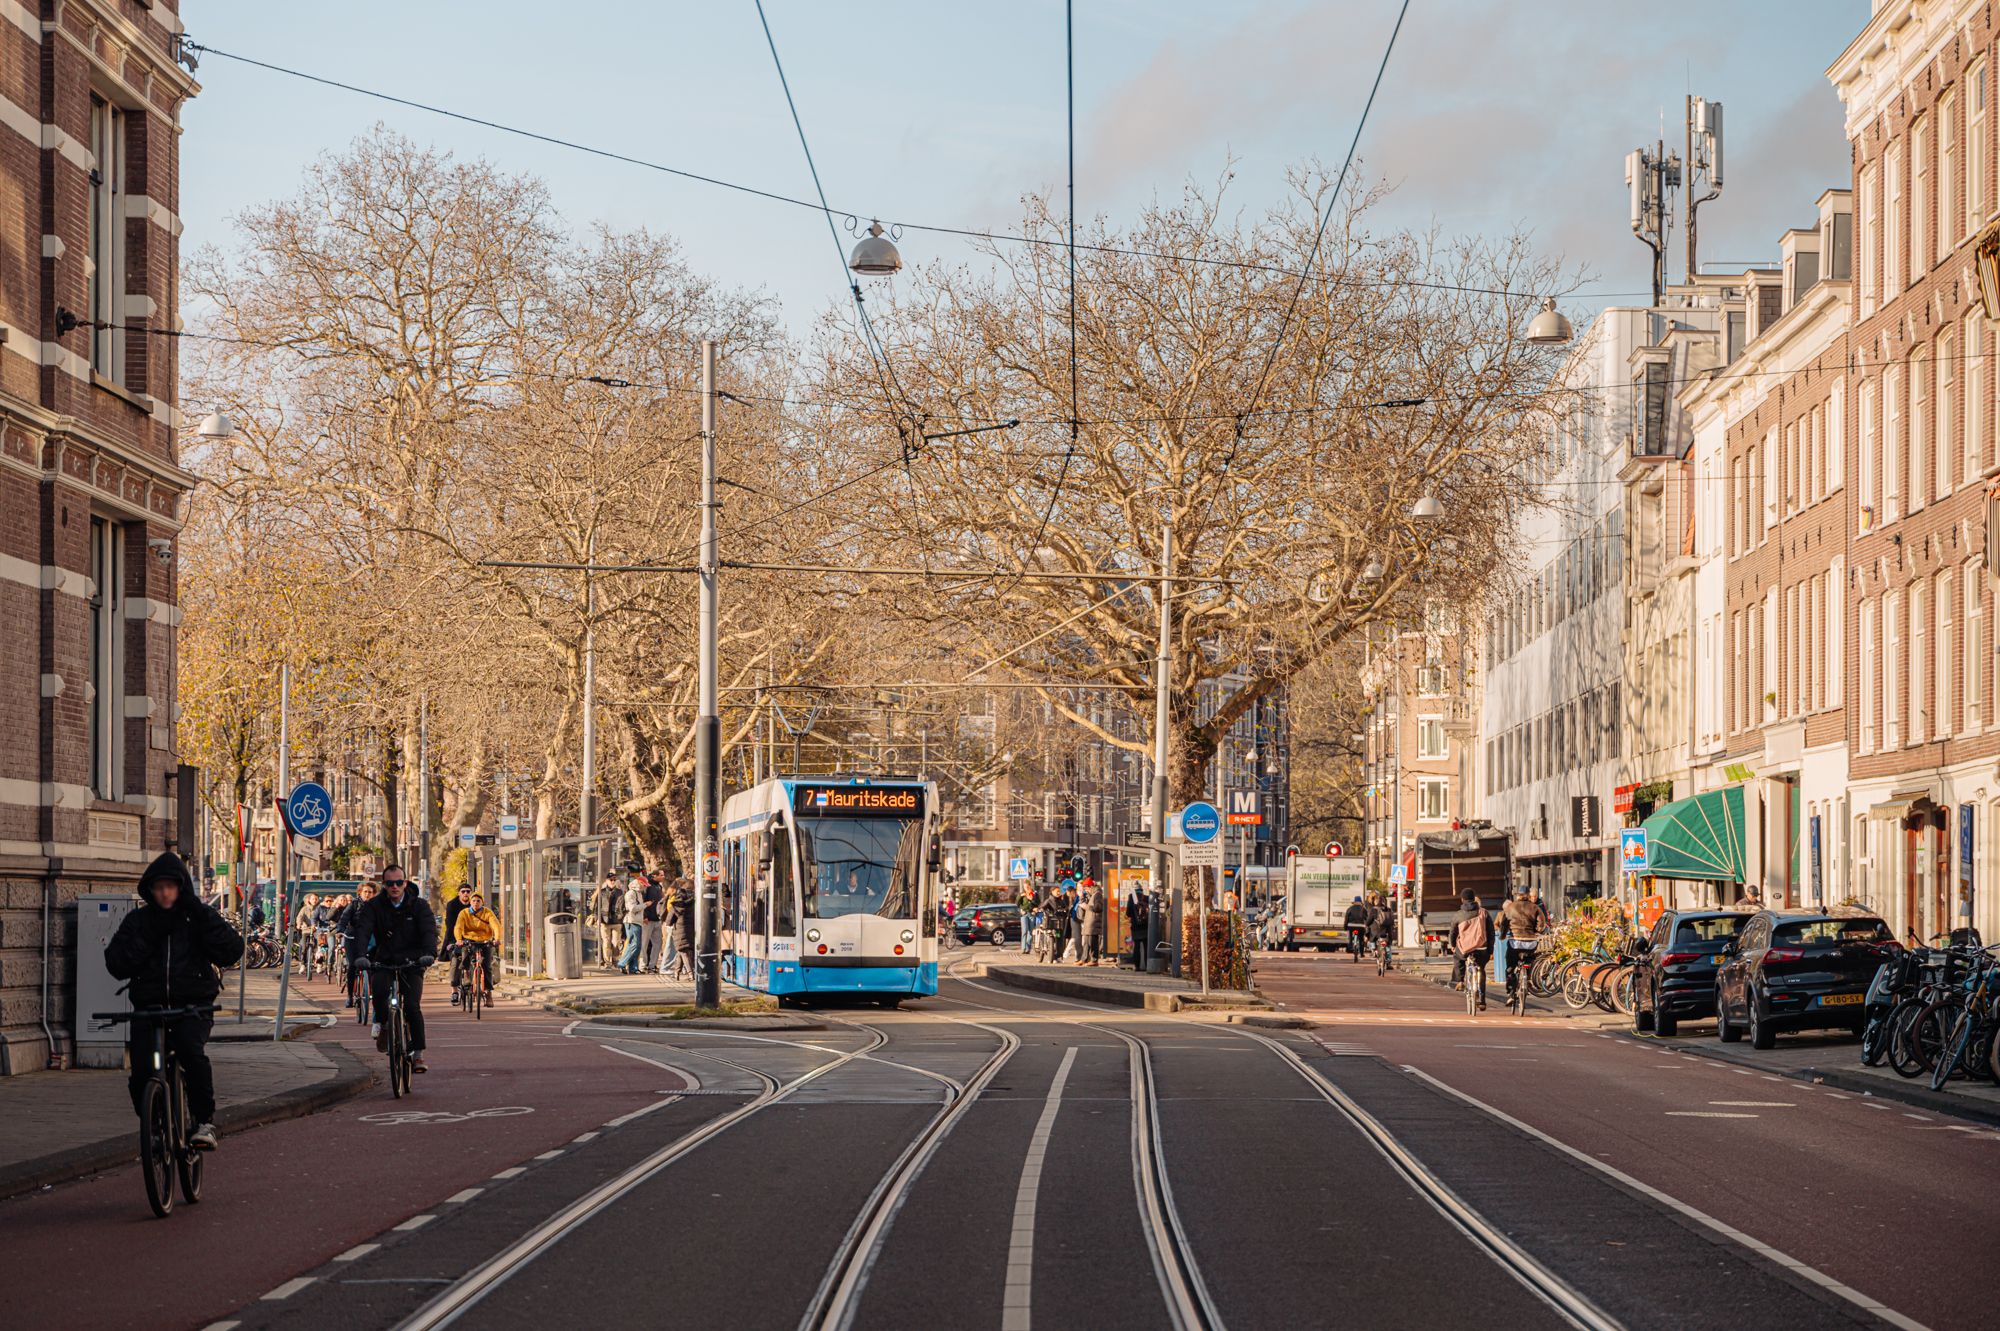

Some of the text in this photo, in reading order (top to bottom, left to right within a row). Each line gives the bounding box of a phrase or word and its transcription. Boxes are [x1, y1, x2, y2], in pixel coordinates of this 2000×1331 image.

[806, 789, 916, 808] 7 Mauritskade
[1234, 792, 1256, 813] M
[1581, 797, 1592, 837] wework
[705, 859, 720, 873] 30
[1300, 872, 1312, 881] JAN
